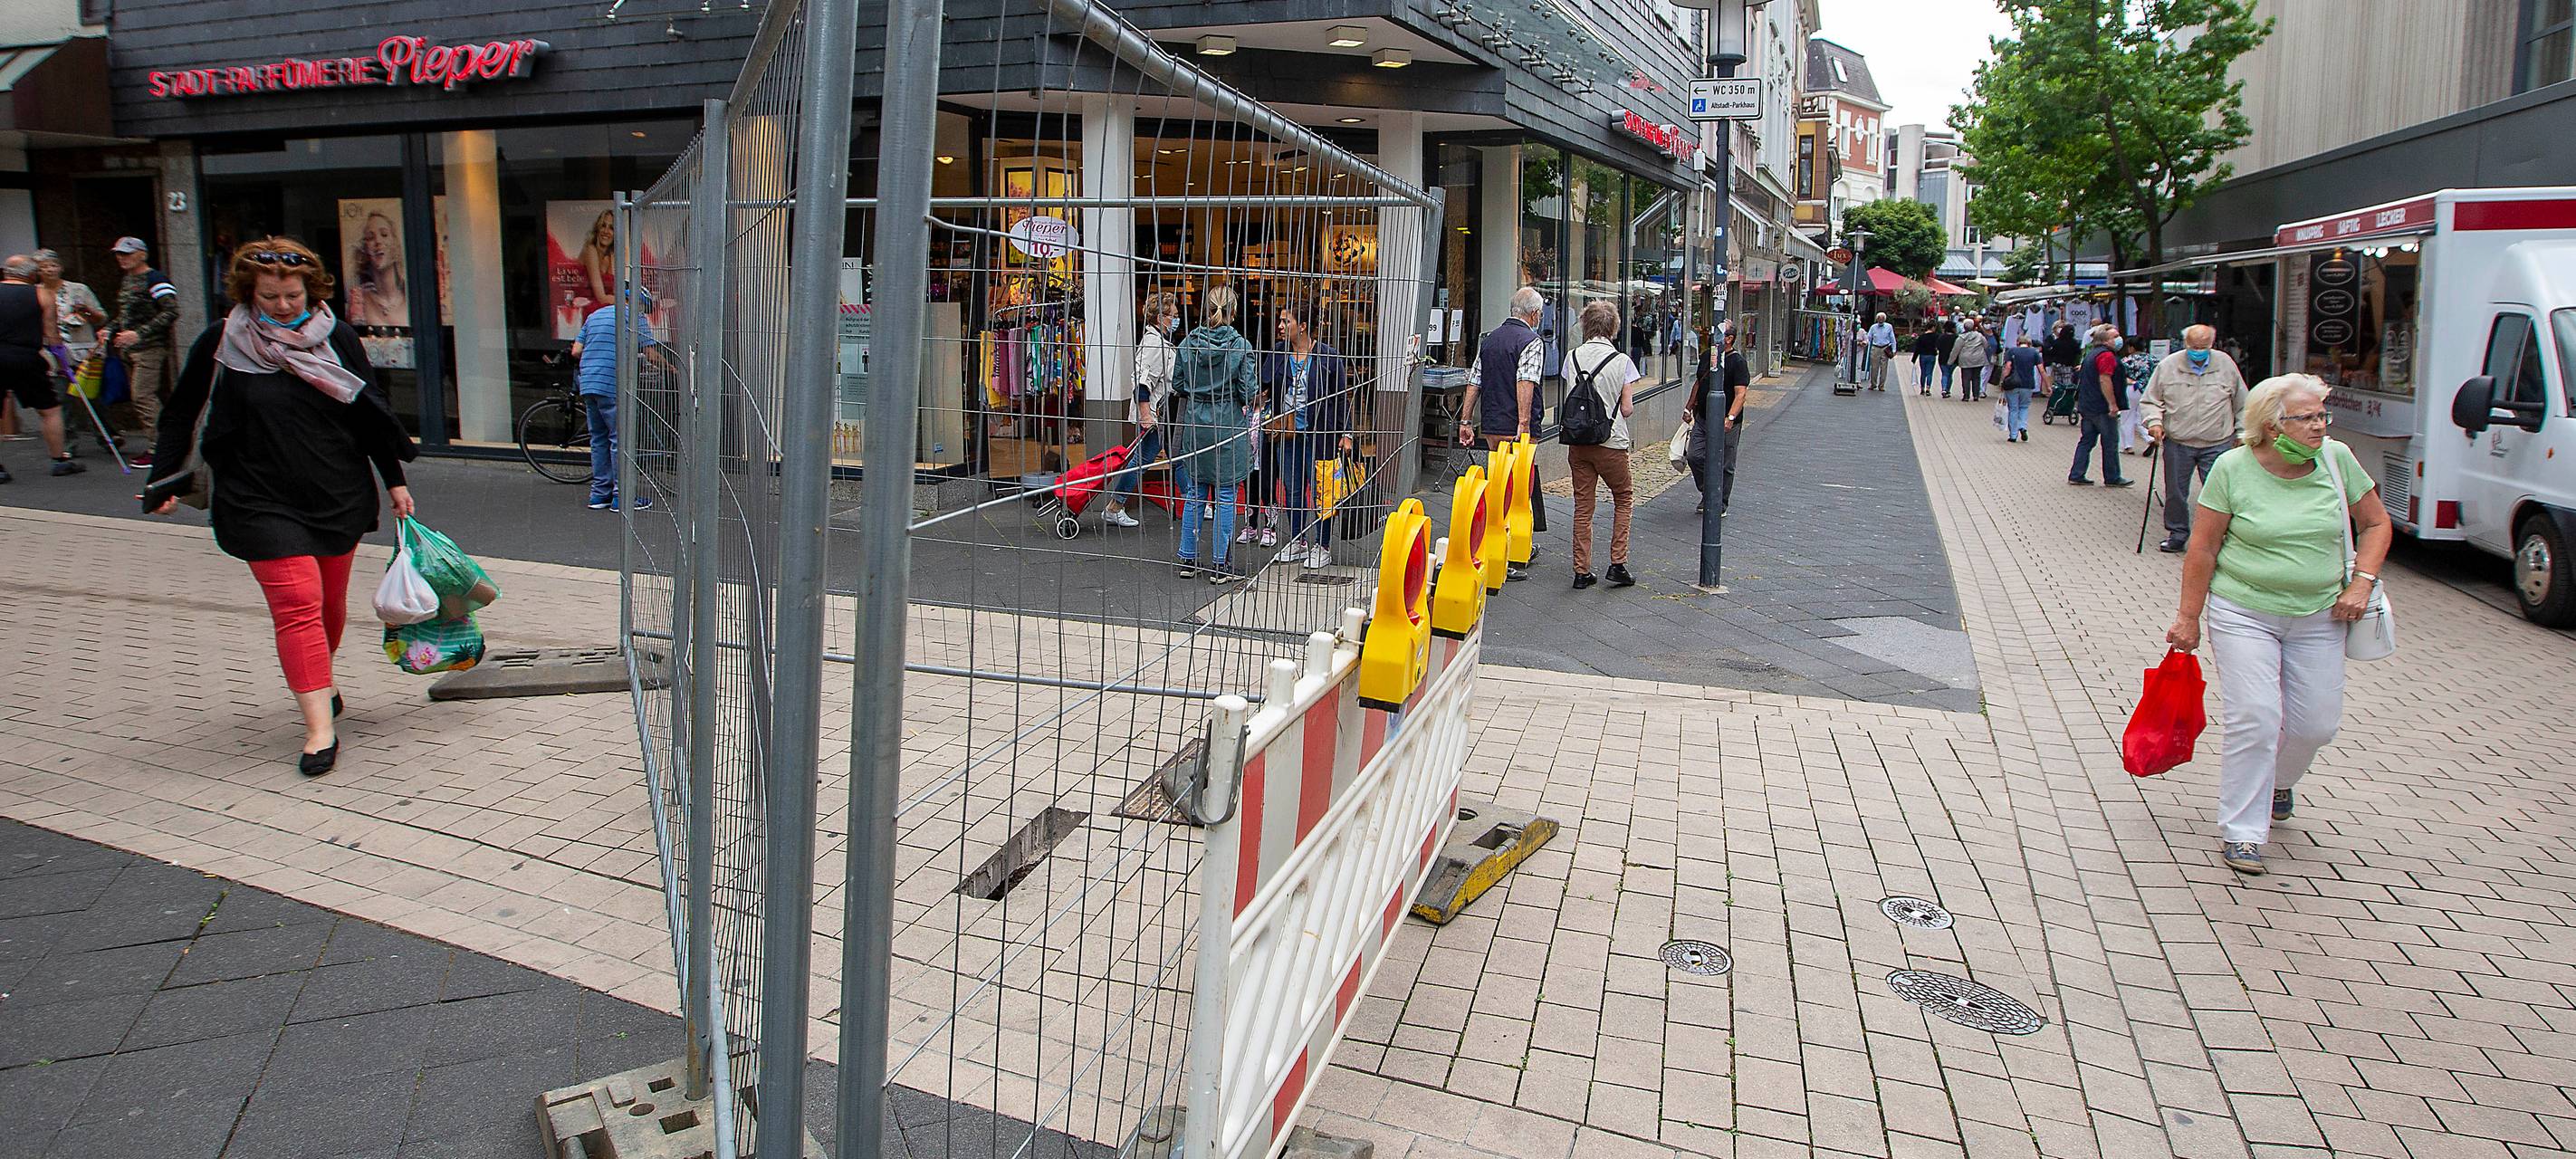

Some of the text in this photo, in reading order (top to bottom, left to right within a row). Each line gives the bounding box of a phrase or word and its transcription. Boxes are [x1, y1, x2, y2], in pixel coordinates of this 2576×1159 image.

[377, 34, 543, 91] Pieper
[1712, 84, 1727, 95] WC
[1729, 84, 1745, 95] 350
[1710, 101, 1756, 109] Altstadt-Parkhaus
[168, 190, 188, 213] 23
[2338, 217, 2361, 235] SAFTIG
[2375, 207, 2406, 228] LECKER
